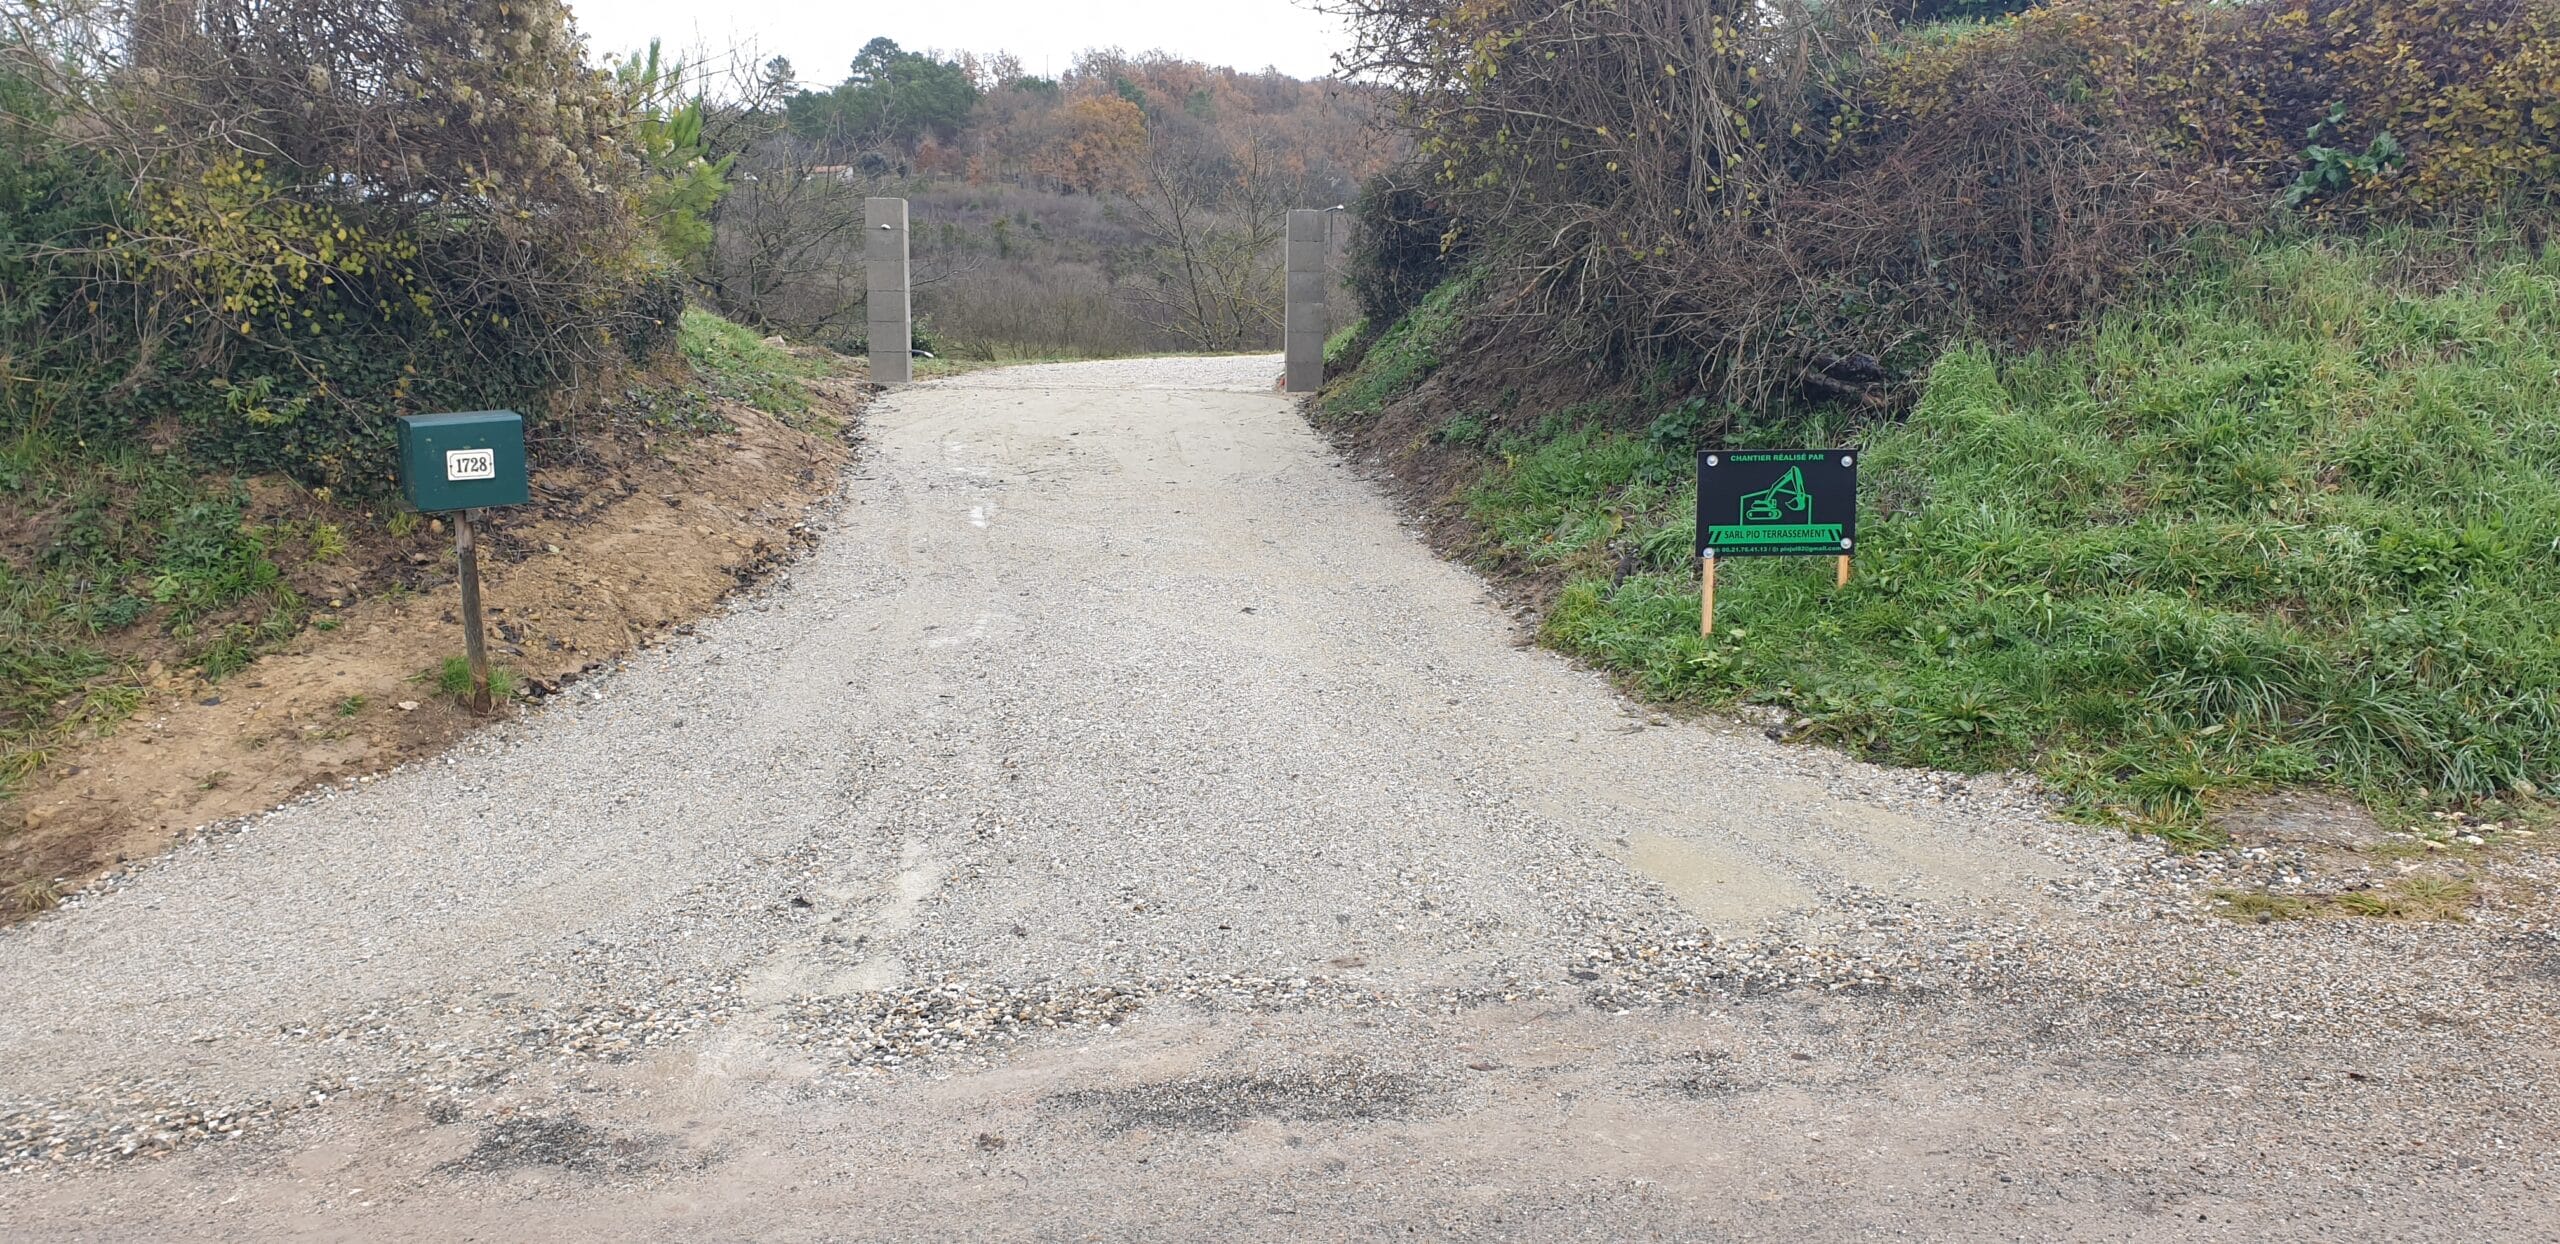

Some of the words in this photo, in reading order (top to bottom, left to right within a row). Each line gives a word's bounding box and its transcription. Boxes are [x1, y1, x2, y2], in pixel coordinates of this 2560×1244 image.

[1730, 454, 1771, 462] CHANTIER
[1773, 453, 1806, 461] RÉALISÉ
[456, 457, 488, 473] 1728
[1724, 530, 1744, 539] SARL
[1762, 529, 1825, 538] TERRASSEMENT
